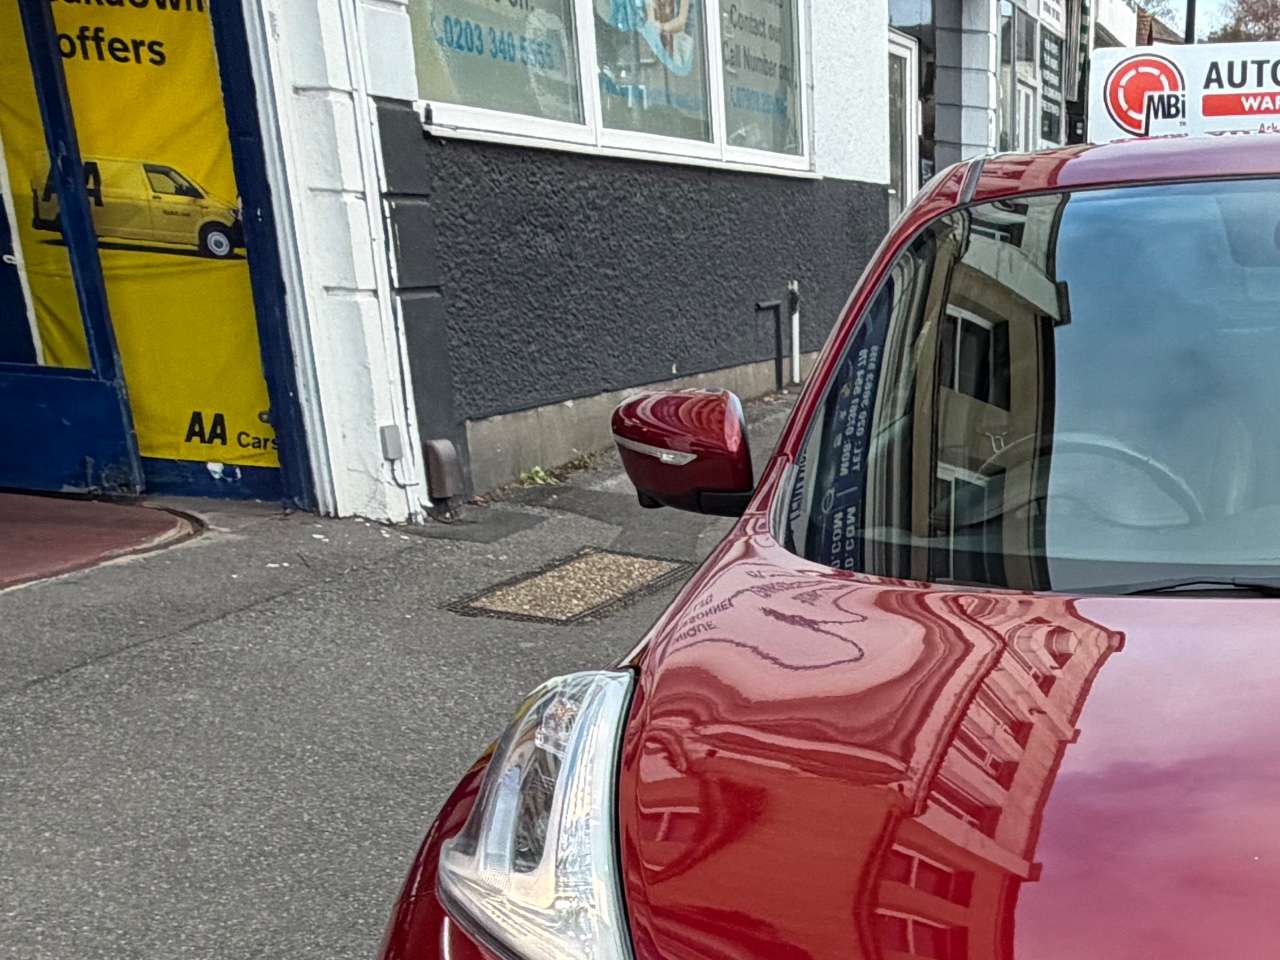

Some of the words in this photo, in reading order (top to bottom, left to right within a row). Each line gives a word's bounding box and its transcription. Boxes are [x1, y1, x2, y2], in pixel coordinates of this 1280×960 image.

[57, 26, 166, 66] offers
[444, 15, 483, 56] 0203
[1146, 94, 1186, 120] MBi
[184, 411, 227, 446] AA
[237, 431, 278, 450] Cars
